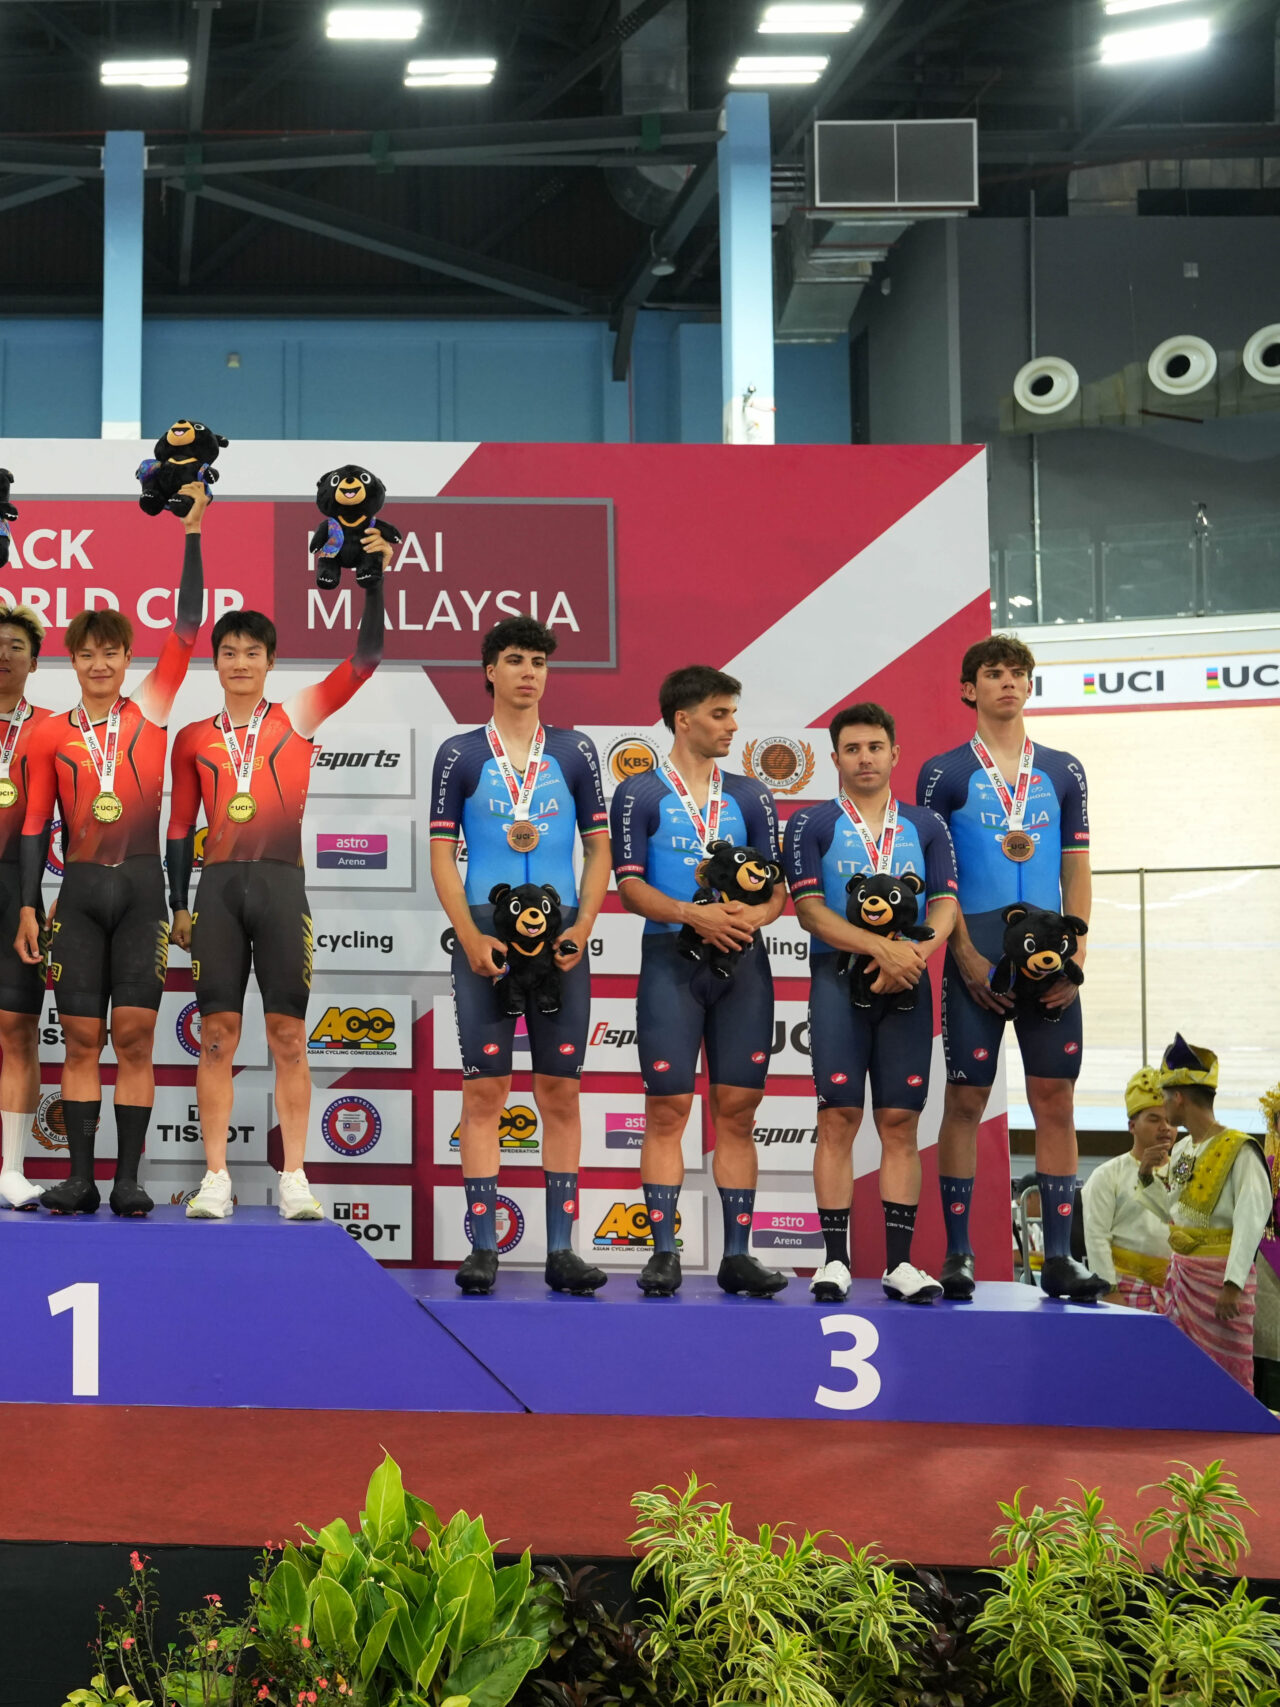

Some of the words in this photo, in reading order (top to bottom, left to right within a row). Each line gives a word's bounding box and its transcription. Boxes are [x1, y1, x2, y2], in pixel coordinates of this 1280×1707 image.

[1098, 670, 1164, 694] UCI
[577, 740, 605, 807] CASTELLI
[623, 757, 650, 769] KBS
[437, 748, 461, 815] CASTELLI
[1067, 762, 1088, 827] CASTELLI
[623, 795, 636, 859] CASTELLI
[336, 838, 368, 849] astro
[795, 813, 810, 875] CASTELLI
[338, 857, 365, 866] Arena
[837, 860, 916, 875] ITAIA
[157, 1125, 255, 1143] TISOT
[771, 1215, 805, 1228] astro
[774, 1237, 802, 1246] Arena
[47, 1282, 99, 1396] 1
[815, 1314, 881, 1411] 3
